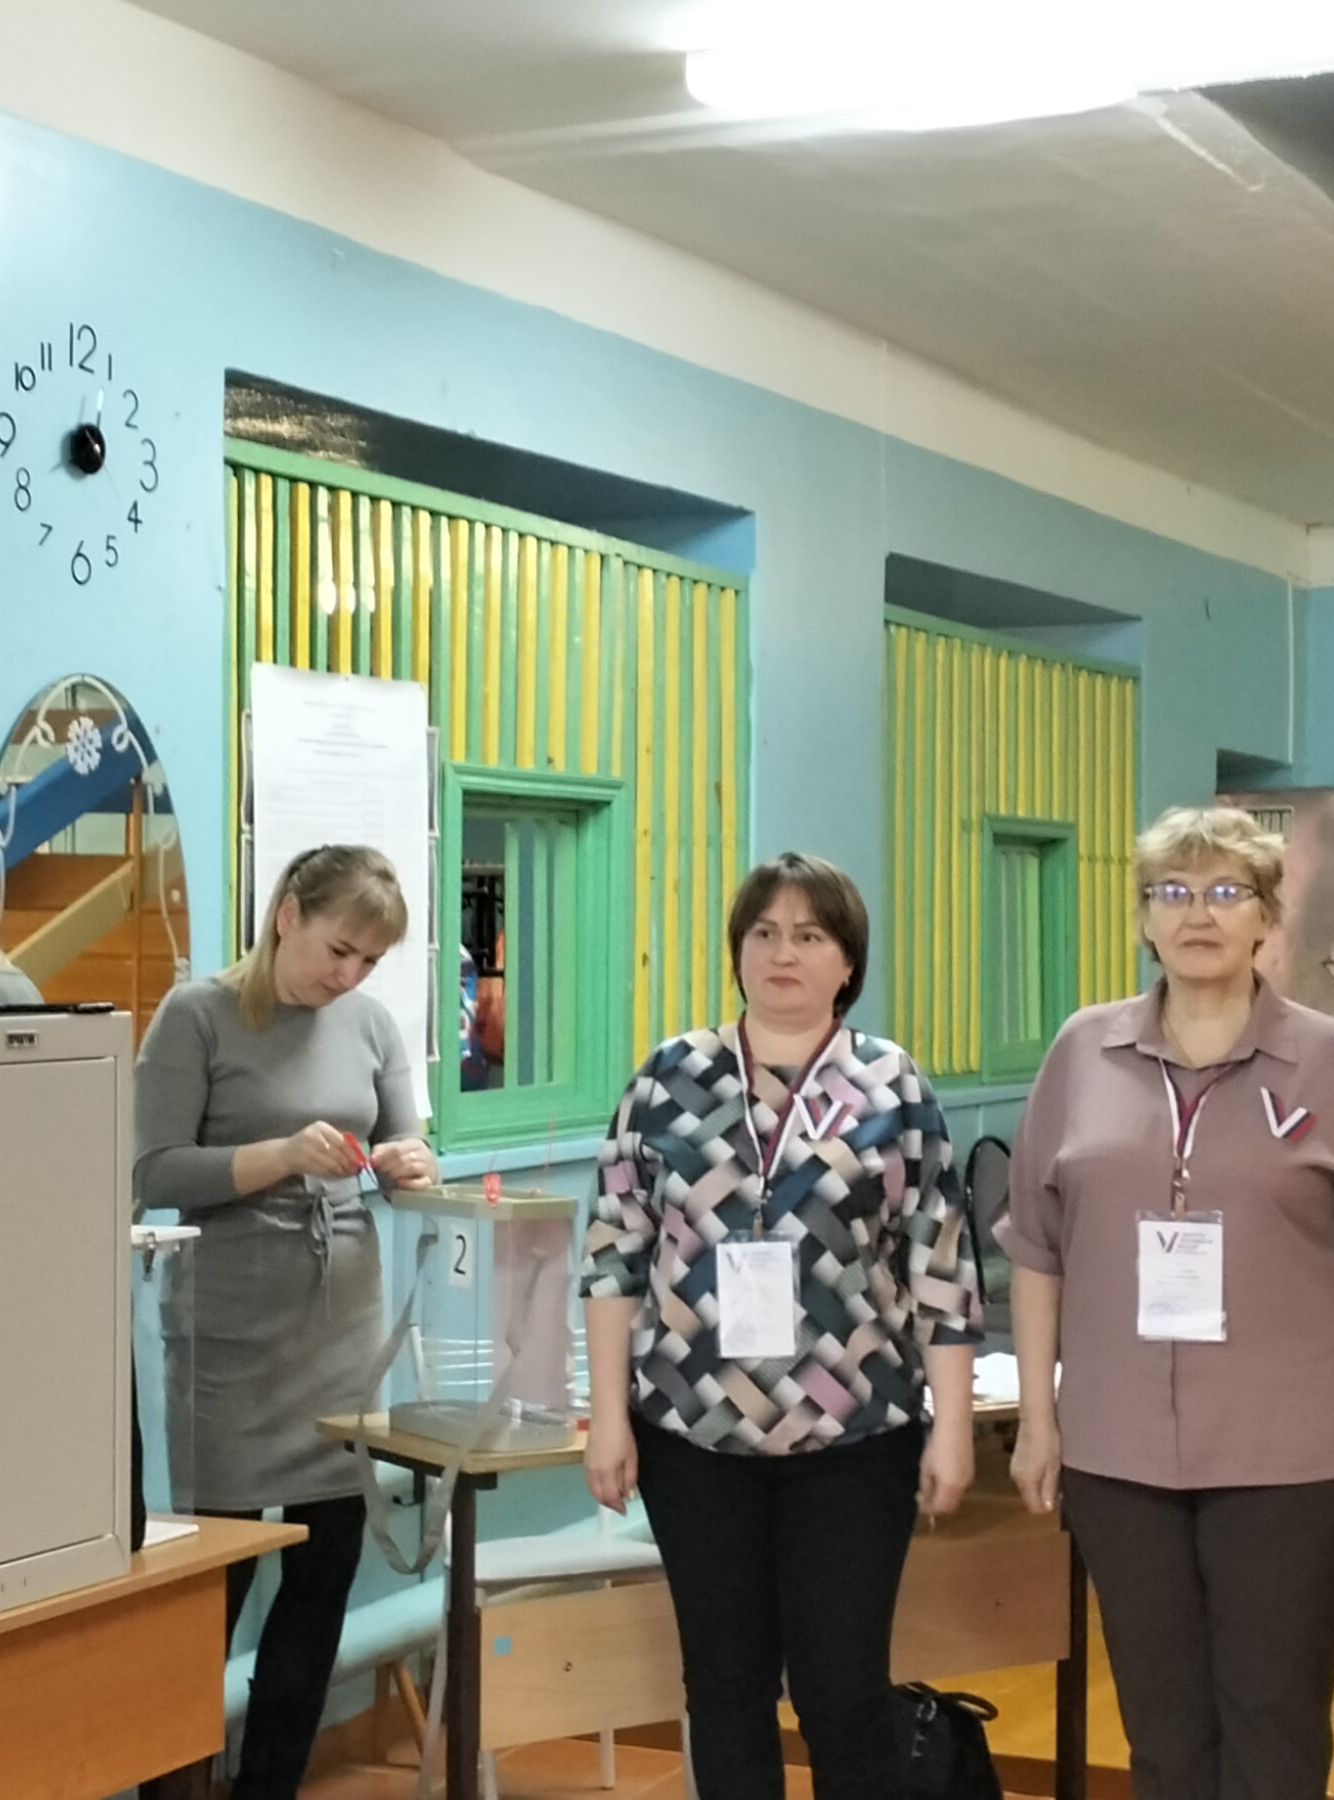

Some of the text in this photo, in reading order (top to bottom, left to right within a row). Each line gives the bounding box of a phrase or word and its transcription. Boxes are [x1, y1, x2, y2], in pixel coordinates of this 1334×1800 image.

[40, 341, 52, 371] 11
[69, 322, 97, 375] 12
[108, 353, 113, 381] 1
[14, 361, 36, 391] 10
[123, 389, 139, 430] 2
[139, 438, 159, 493] 3
[14, 467, 31, 512] 8
[39, 522, 53, 546] 7
[127, 499, 143, 534] 4
[70, 540, 92, 585] 6
[105, 534, 119, 568] 5
[454, 1234, 466, 1275] 2
